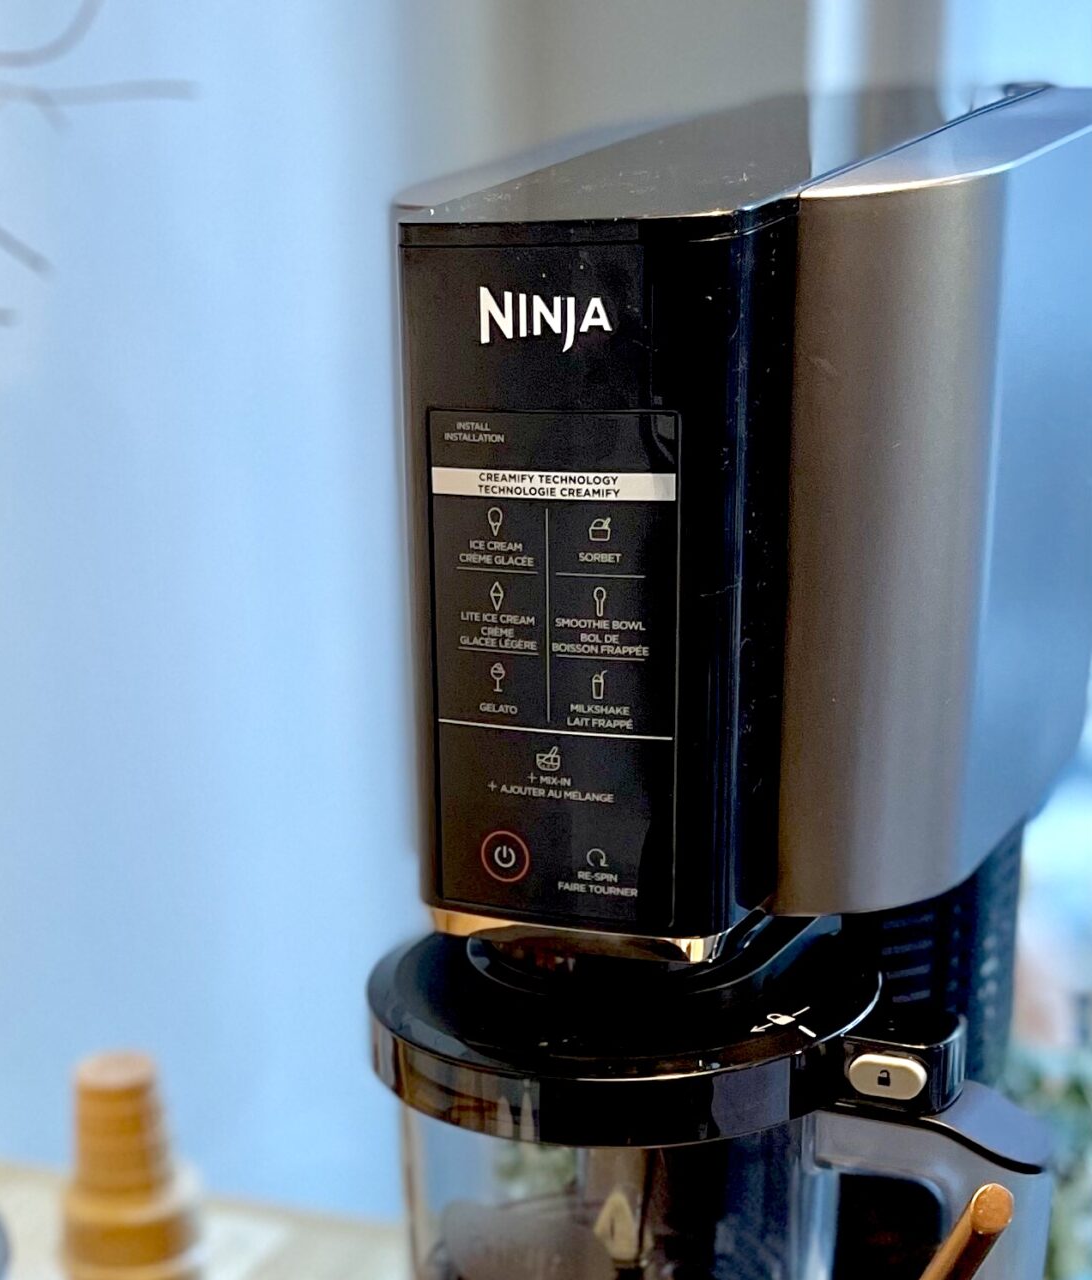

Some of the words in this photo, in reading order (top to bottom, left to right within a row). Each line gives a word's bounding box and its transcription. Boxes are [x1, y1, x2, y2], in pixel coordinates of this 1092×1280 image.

[479, 286, 613, 352] NINJA
[456, 421, 491, 431] INSTALL
[444, 432, 505, 443] INSTALLATION
[478, 473, 535, 484] CREAMIFY
[538, 474, 619, 485] TECHNOLOGY
[477, 485, 556, 497] TECHNOLOGIE
[559, 487, 621, 498] CREAMIFY
[469, 540, 485, 550] ICE
[487, 541, 523, 552] CREAM
[578, 552, 623, 563] SORBET
[460, 611, 480, 621] LITE
[482, 613, 498, 623] ICE
[499, 614, 536, 626] CREAM
[554, 618, 610, 630] SMOOTHIE
[611, 620, 646, 631] BOWL
[580, 633, 602, 643] BOL
[604, 634, 620, 645] DE
[551, 642, 599, 654] BOISSON
[479, 702, 518, 715] GELATO
[569, 703, 631, 716] MILKSHAKE
[566, 716, 590, 727] LAIT
[539, 775, 572, 787] MIX-IN
[499, 784, 546, 798] AJOUTER
[547, 787, 563, 799] AU
[577, 870, 618, 883] RE-SPIN
[557, 881, 587, 893] FAIRE
[588, 884, 639, 898] TOURNER
